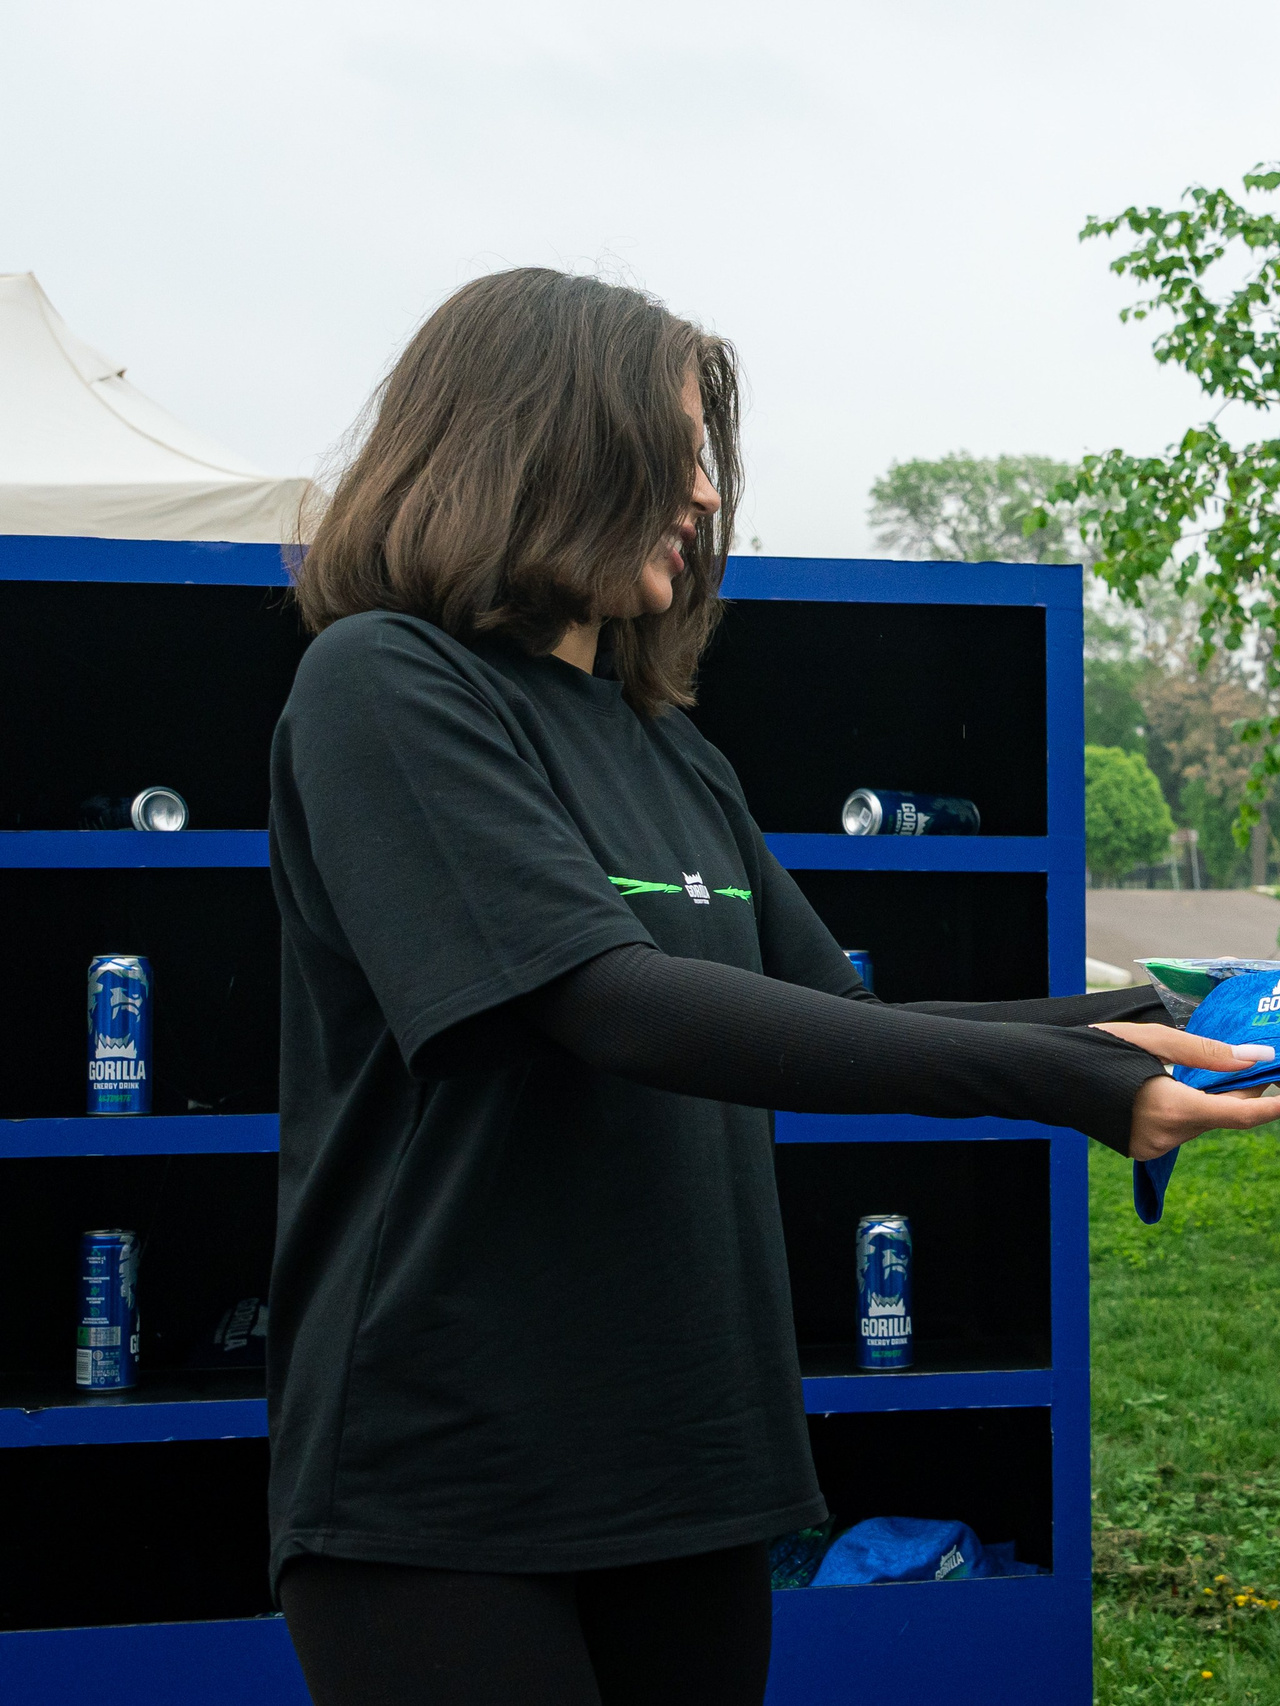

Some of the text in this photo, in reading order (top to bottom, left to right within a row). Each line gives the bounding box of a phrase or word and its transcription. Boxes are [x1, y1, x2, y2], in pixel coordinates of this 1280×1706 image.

[89, 1060, 146, 1080] GORILLA
[93, 1082, 140, 1090] ENERGY DRINK
[861, 1316, 912, 1337] GORILLA
